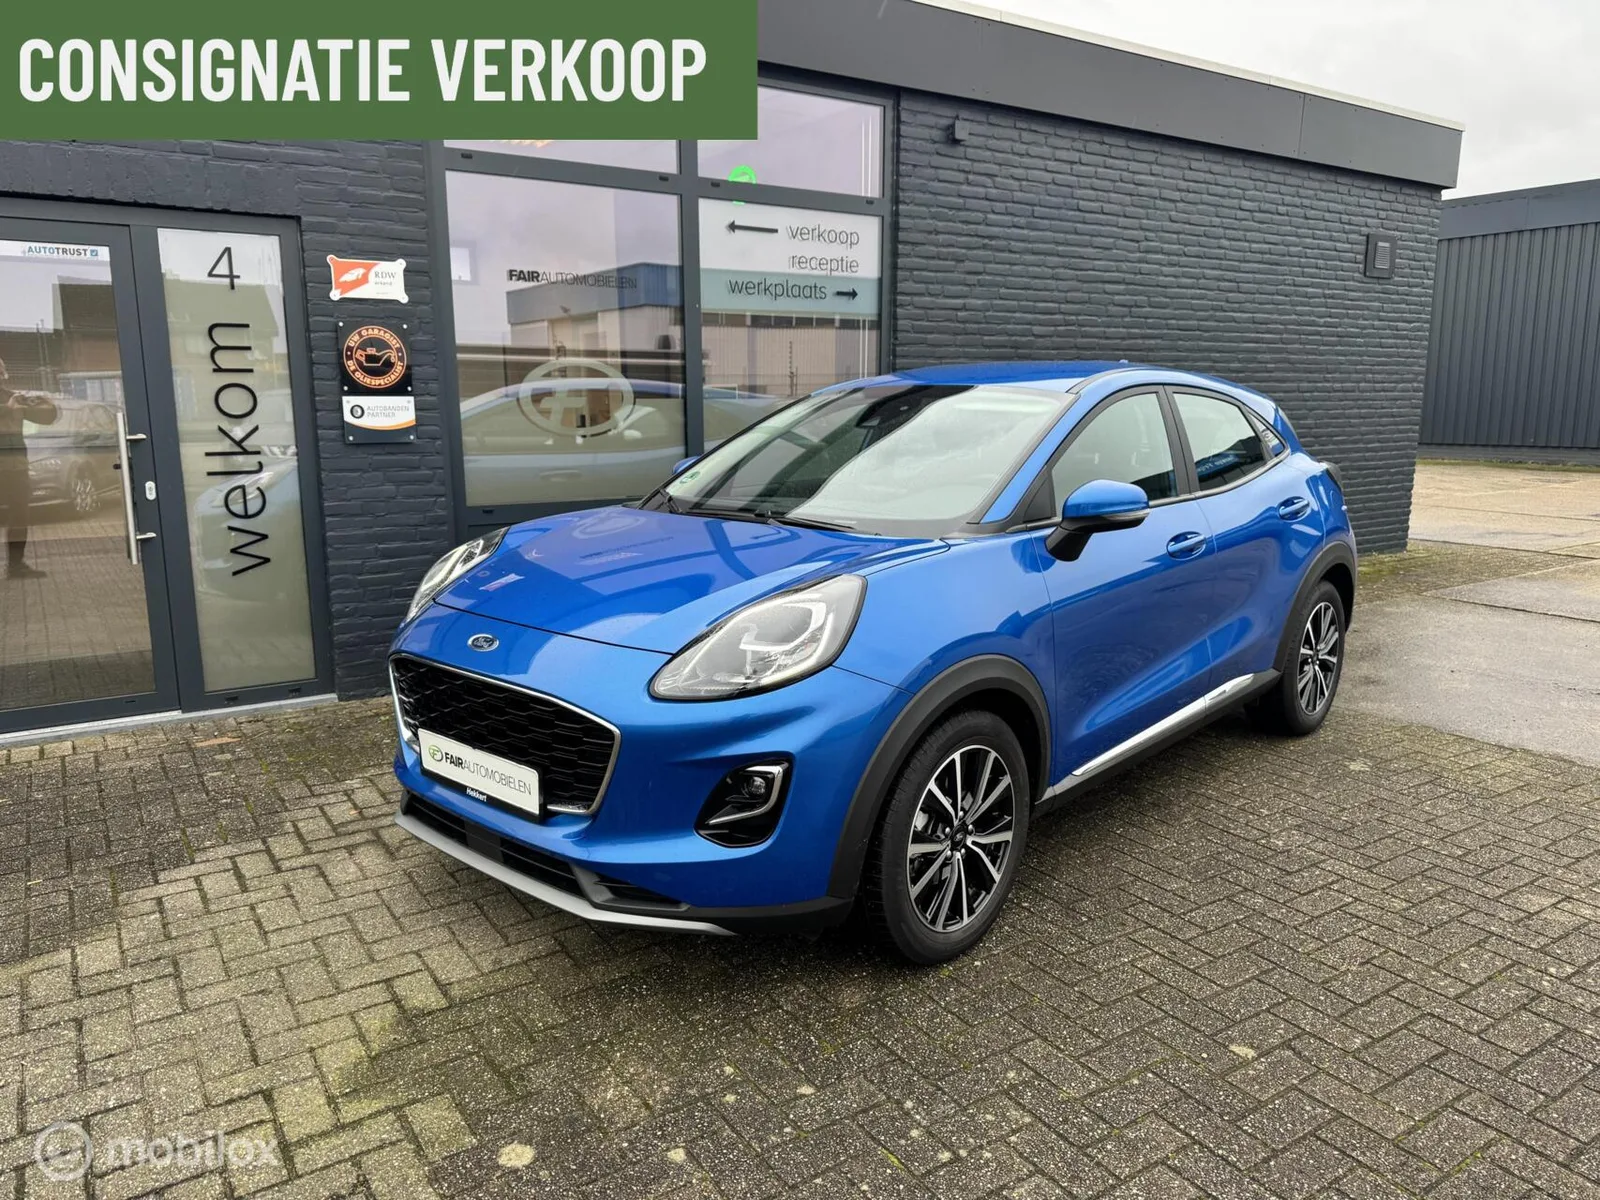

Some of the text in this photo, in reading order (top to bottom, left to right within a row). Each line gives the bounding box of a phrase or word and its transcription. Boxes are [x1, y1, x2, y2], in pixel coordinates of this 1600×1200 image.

[788, 224, 860, 248] verkoop
[27, 245, 89, 257] AUTOTRUST
[374, 270, 397, 279] RDW
[790, 253, 860, 276] receptie
[507, 269, 637, 289] FAIRAUTOMOBIELEN
[728, 278, 827, 300] werkplaats
[348, 333, 360, 347] UW
[204, 246, 271, 577] welkom 4
[444, 752, 532, 795] FAIRAUTOMOBIELEN
